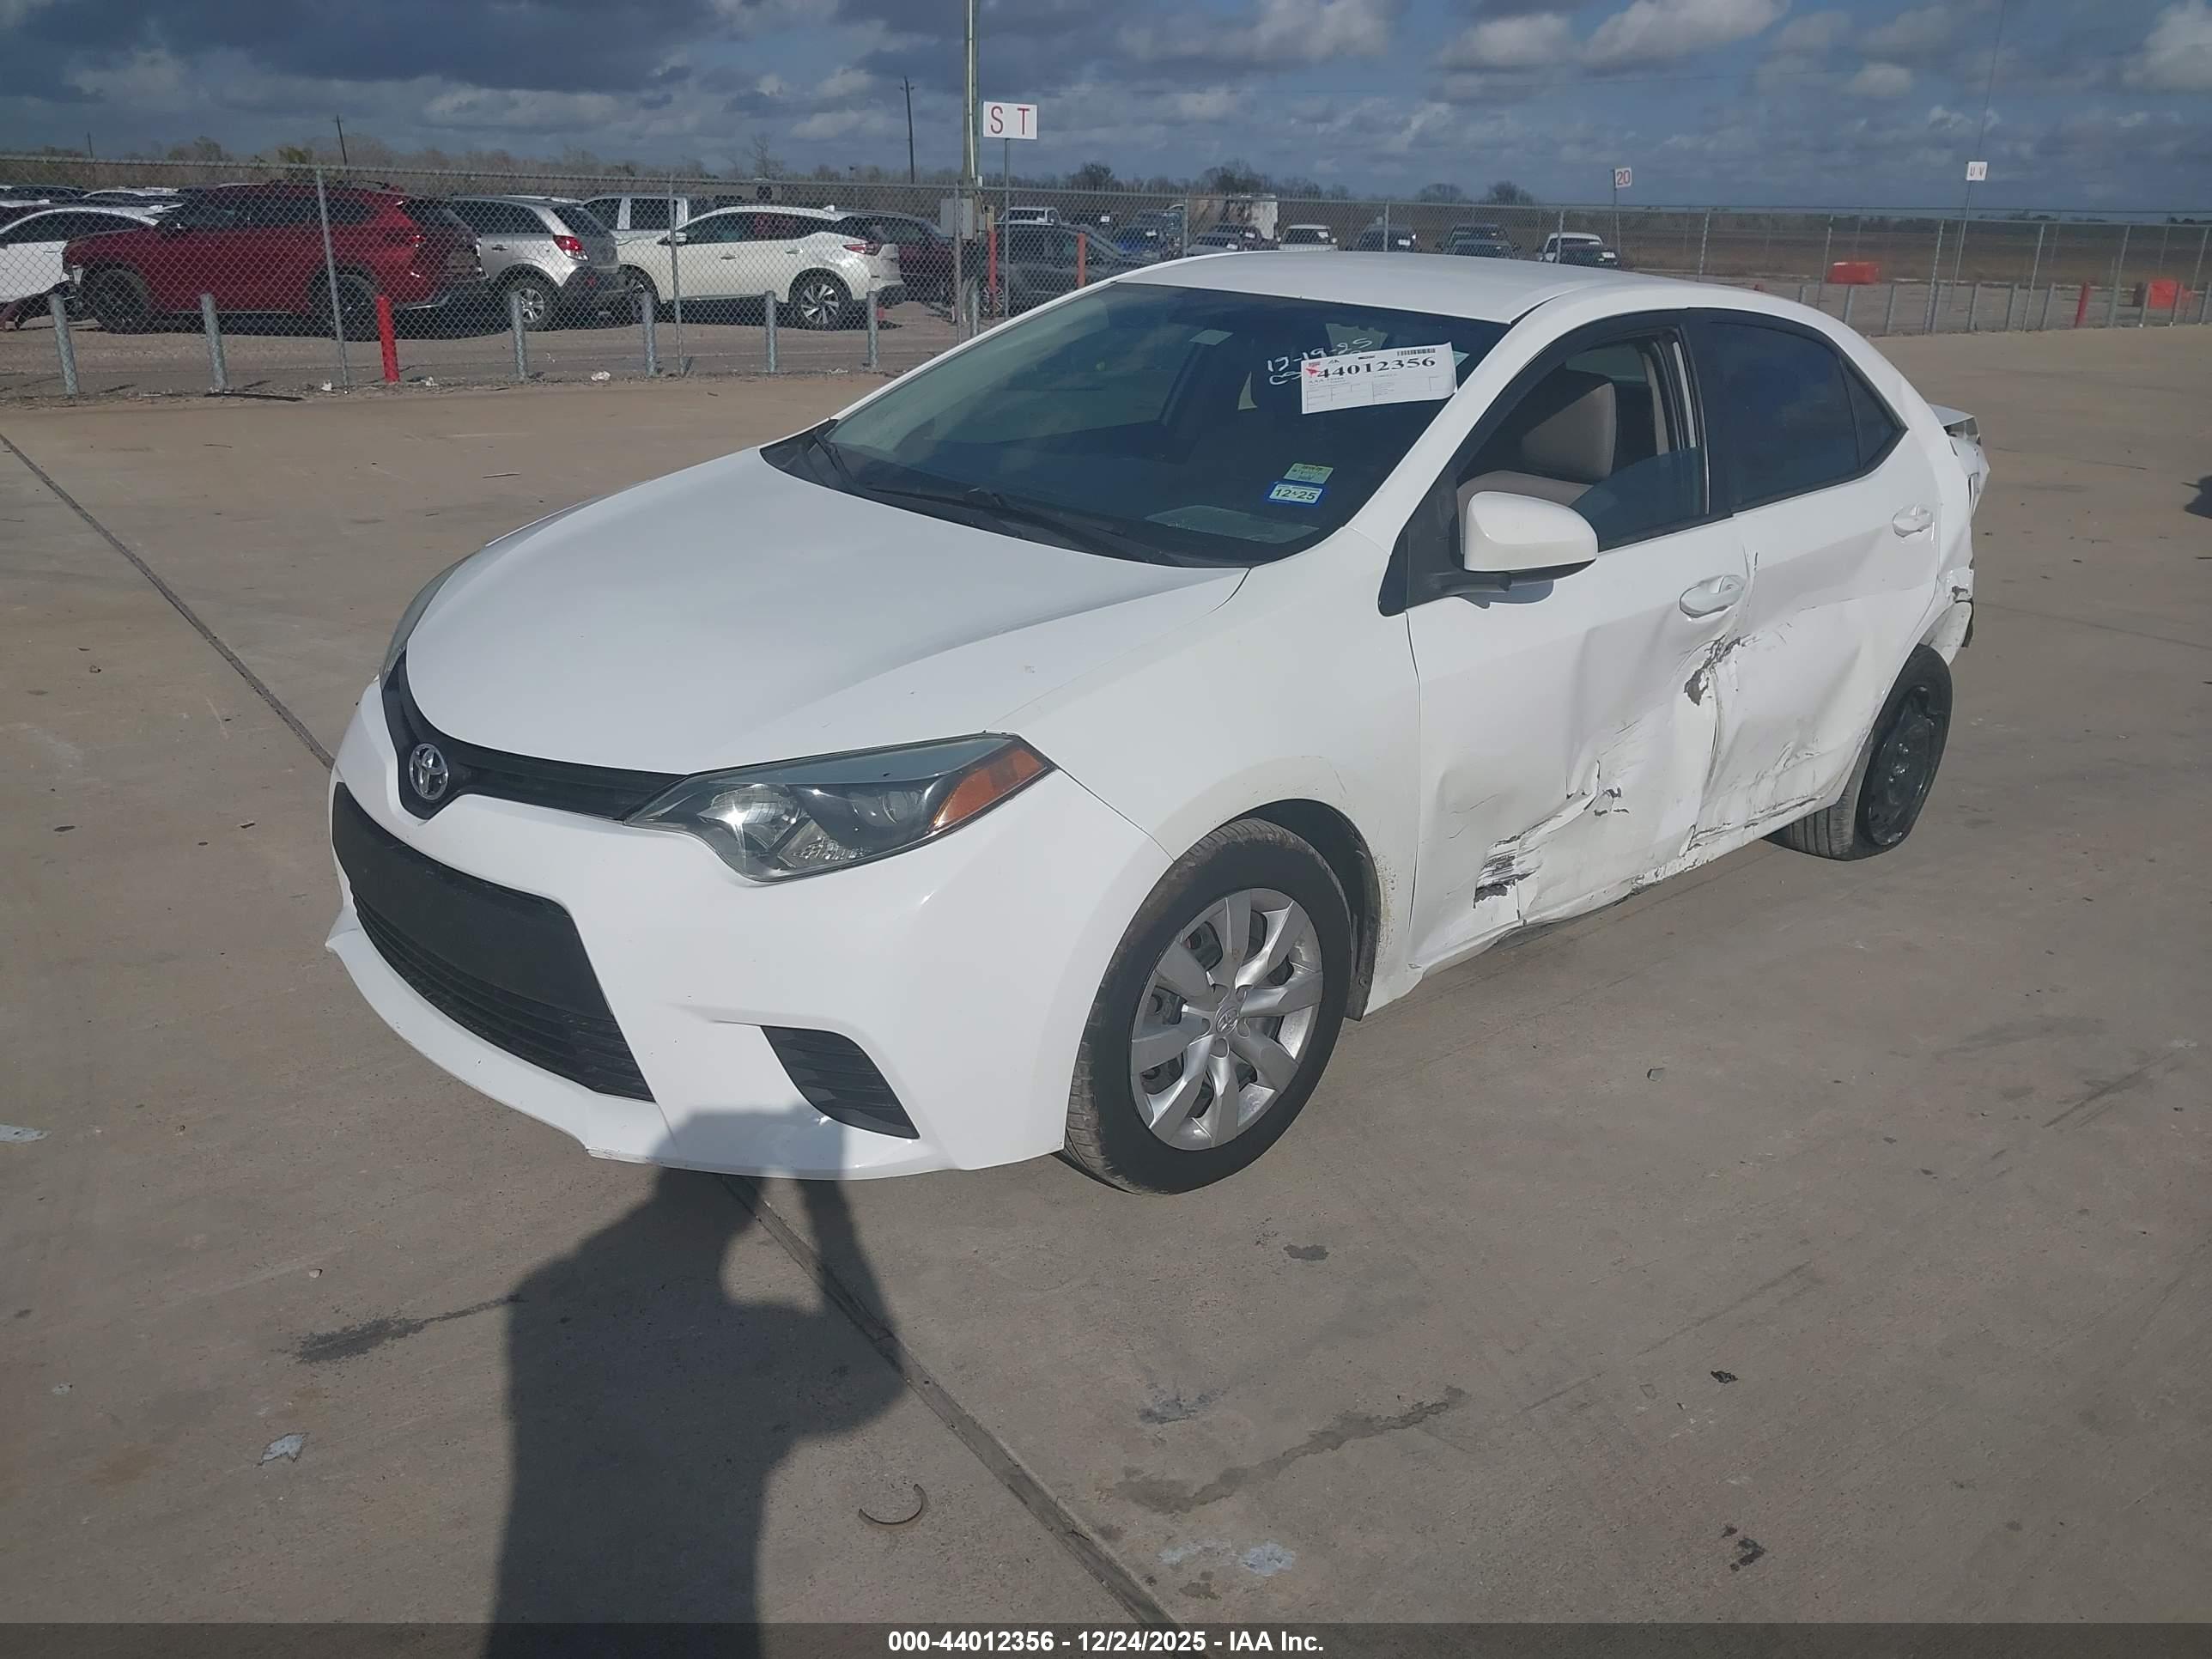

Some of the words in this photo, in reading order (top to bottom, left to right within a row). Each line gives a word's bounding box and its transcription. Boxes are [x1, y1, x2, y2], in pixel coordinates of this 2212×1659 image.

[990, 106, 1003, 134] S
[1017, 107, 1030, 136] T
[1616, 169, 1631, 186] 20
[1317, 356, 1436, 379] 44012356
